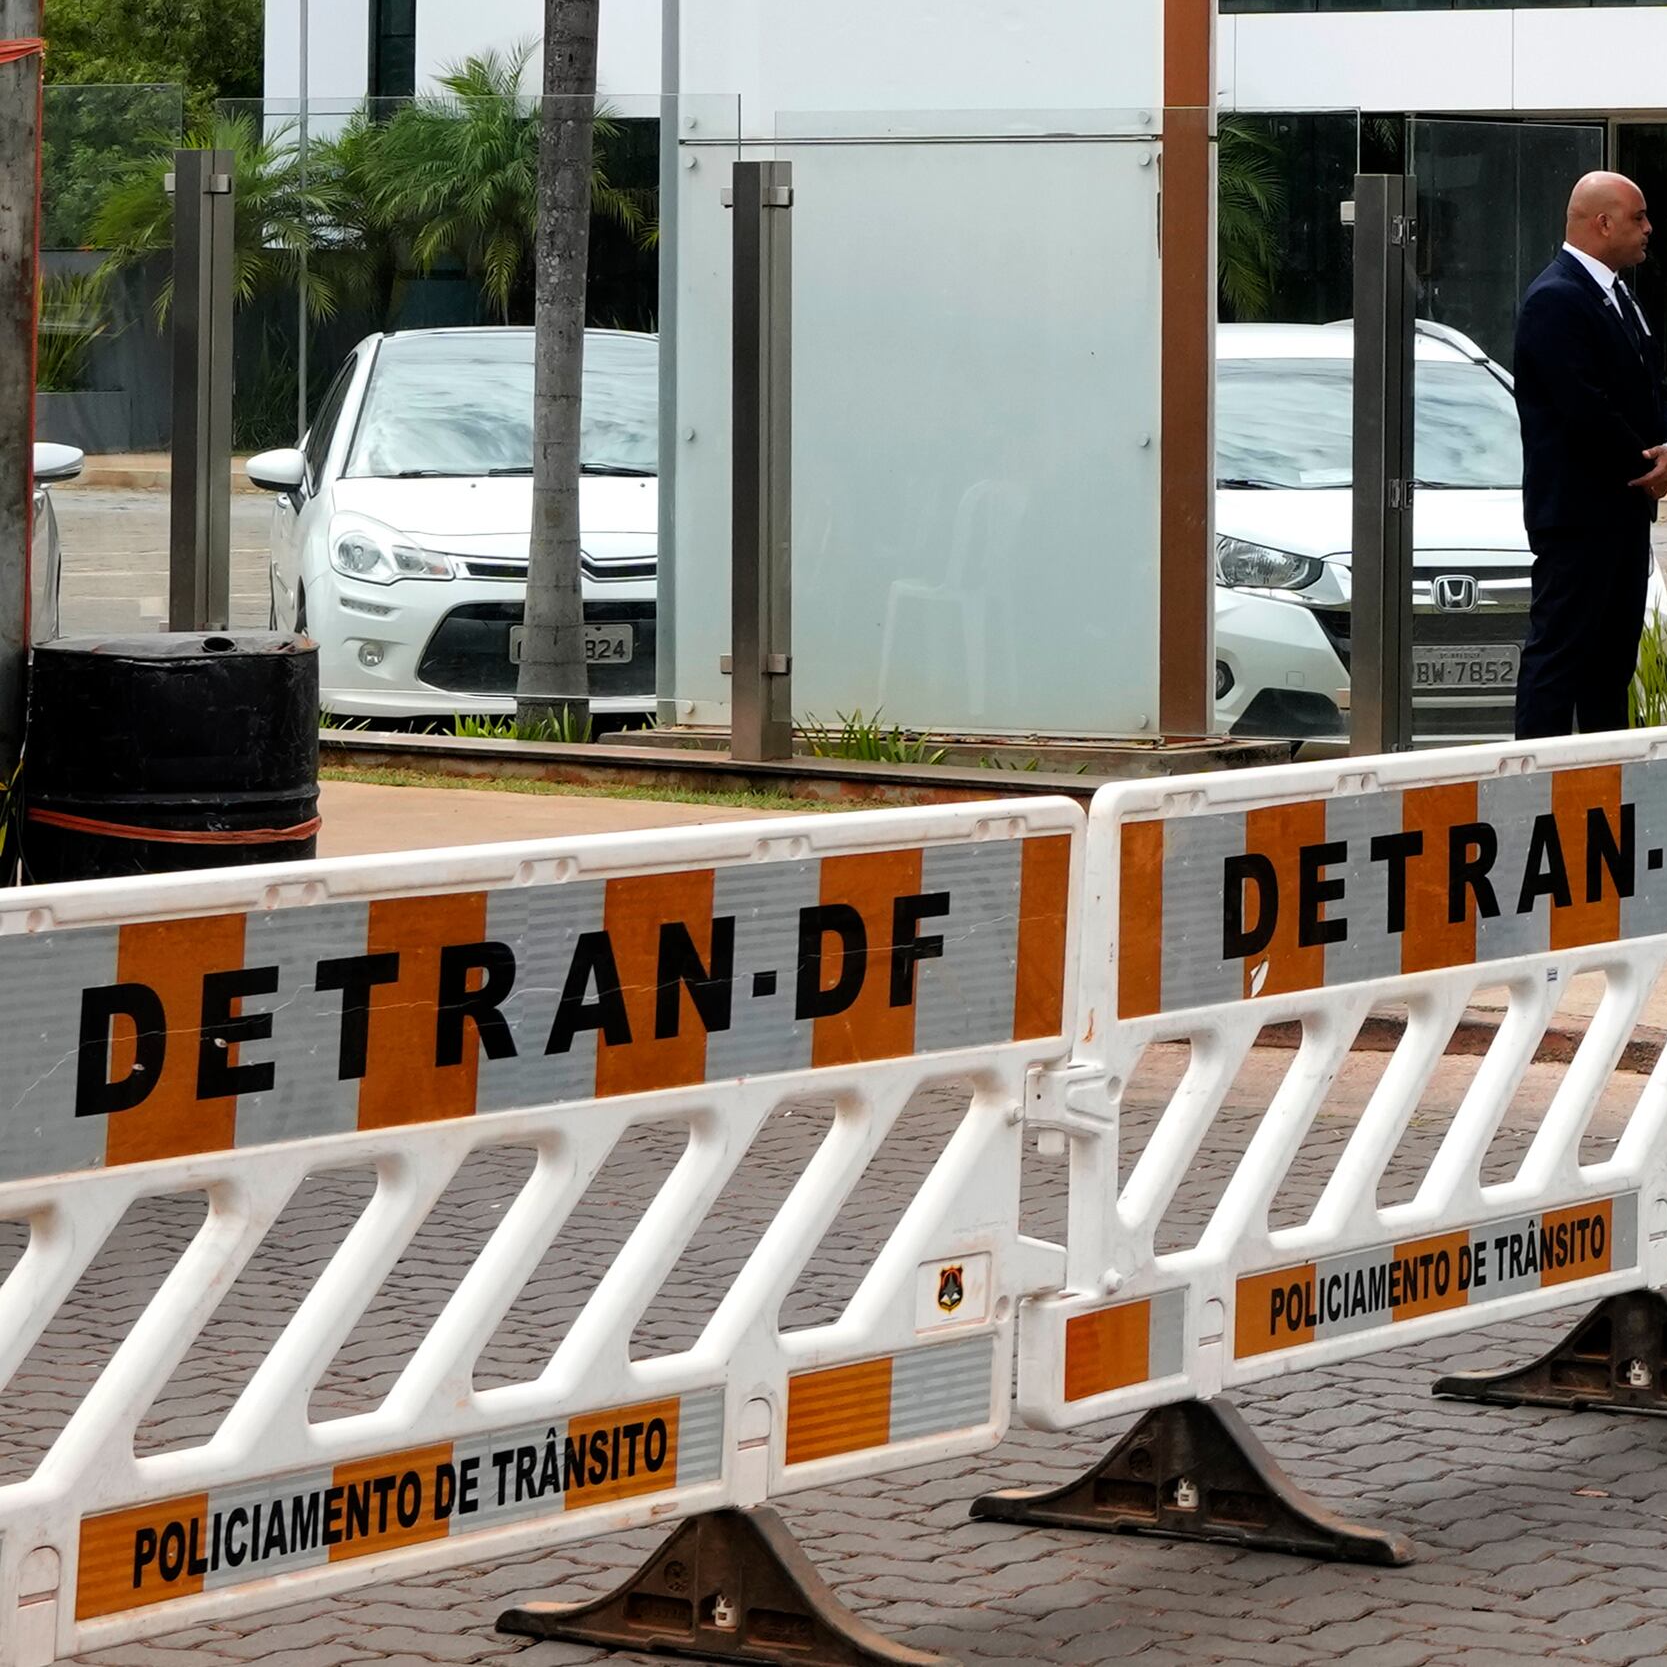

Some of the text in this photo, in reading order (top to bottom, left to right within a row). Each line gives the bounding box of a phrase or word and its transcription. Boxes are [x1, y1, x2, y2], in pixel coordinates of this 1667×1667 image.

[1269, 1213, 1605, 1335] POLICIAMENTO DE TRÂNSITO
[133, 1418, 669, 1590] POLICIAMENTO DE TRÂNSITO
